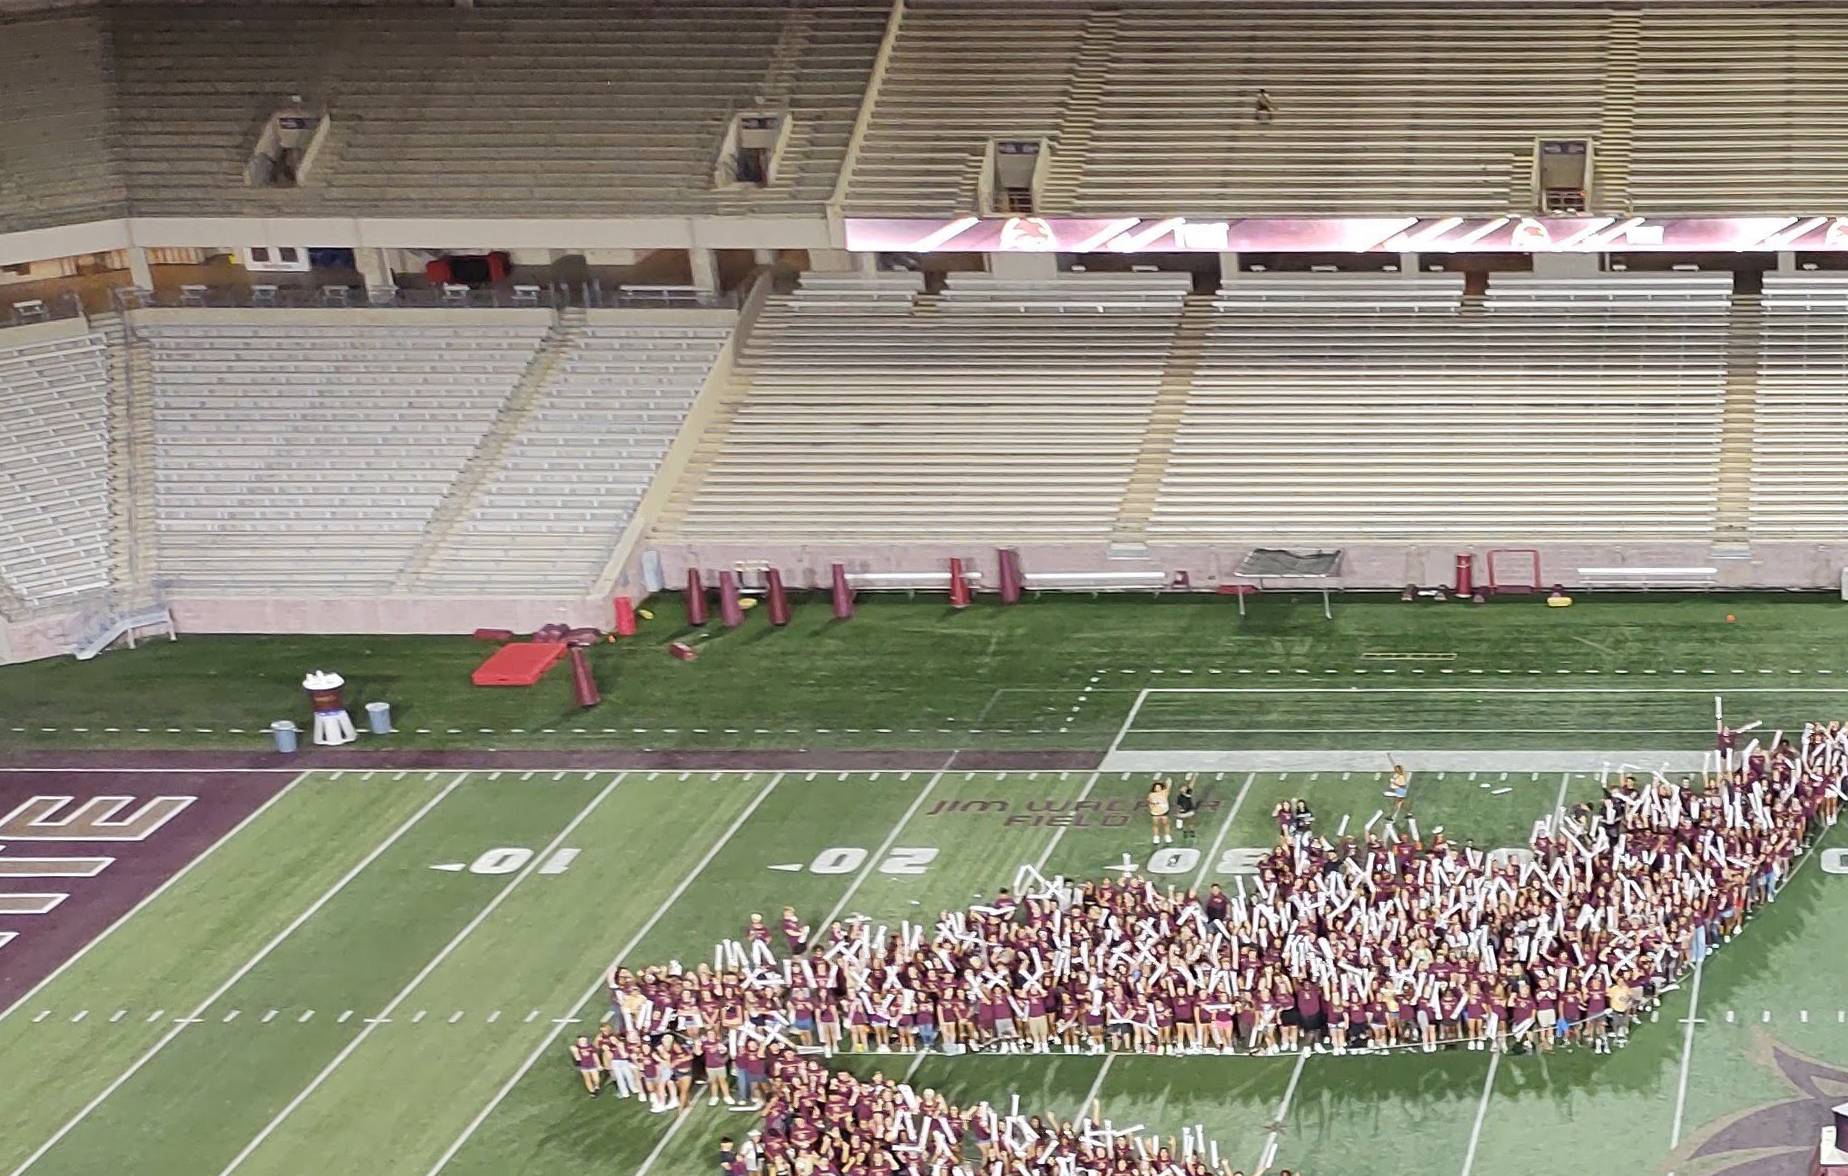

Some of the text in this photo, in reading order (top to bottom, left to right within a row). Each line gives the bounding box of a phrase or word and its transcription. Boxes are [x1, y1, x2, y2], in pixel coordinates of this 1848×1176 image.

[926, 800, 1221, 815] JIM WACR
[1003, 814, 1131, 828] FIELD
[469, 848, 582, 874] 10
[809, 848, 940, 874] 20
